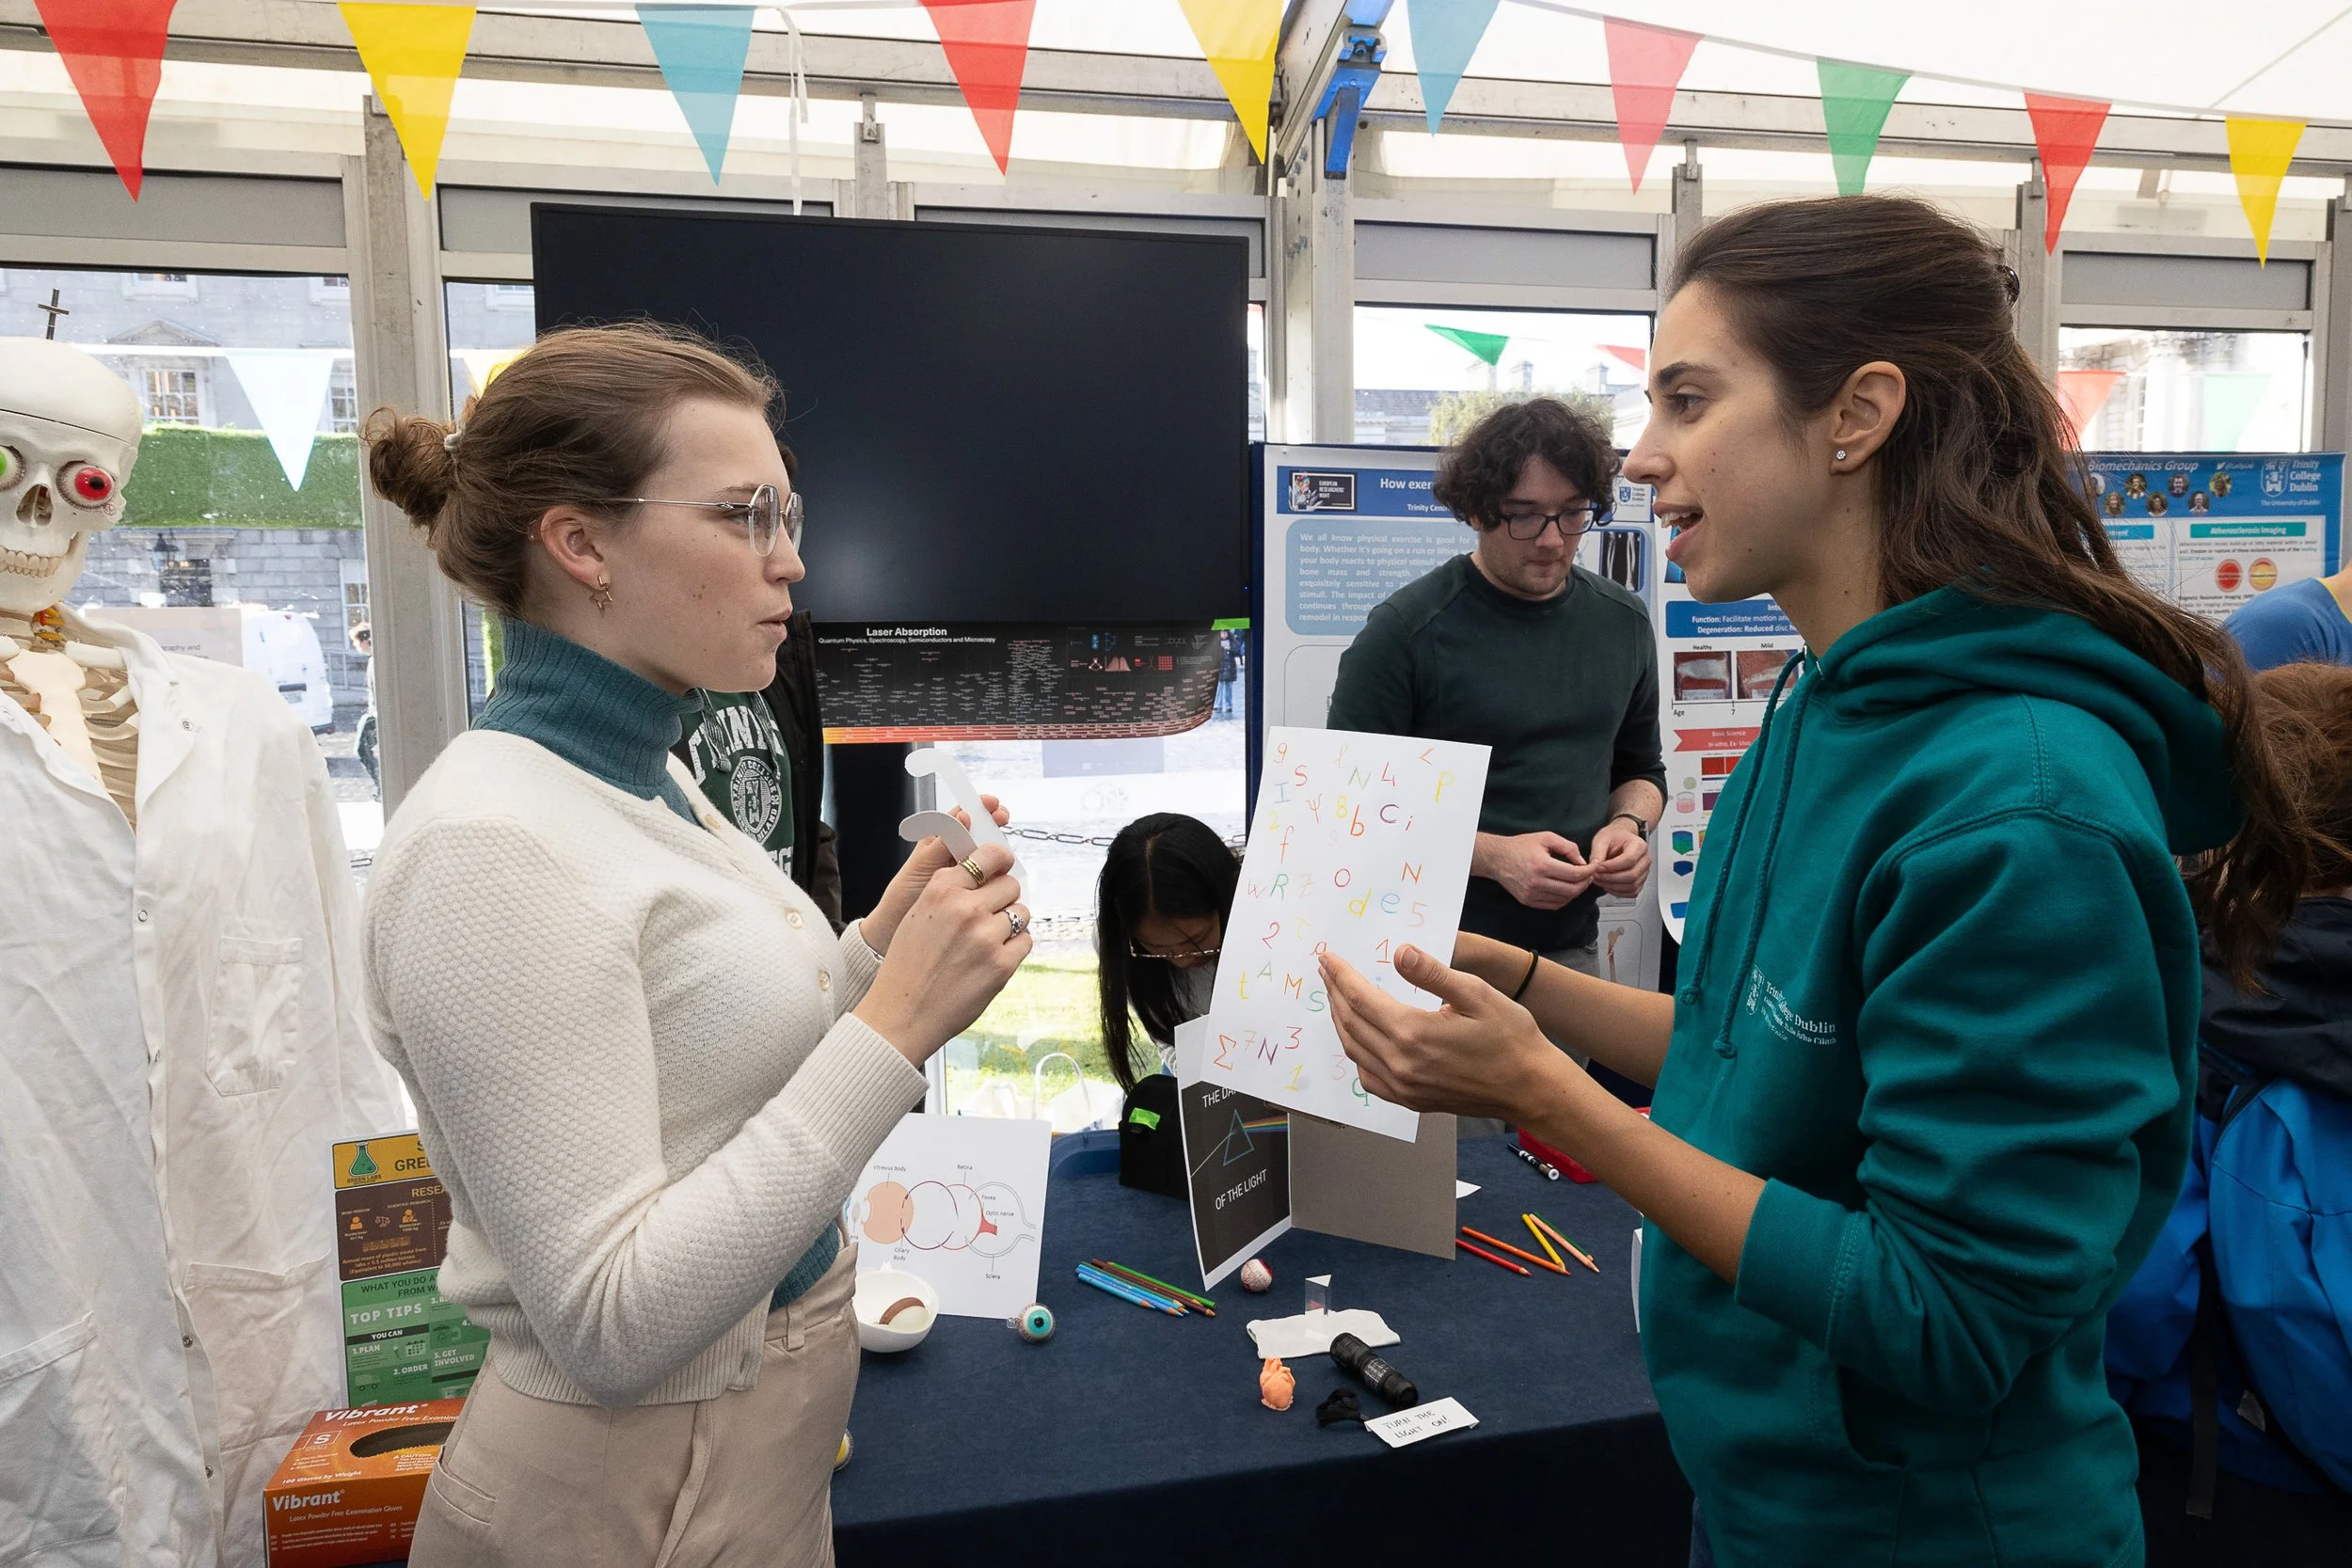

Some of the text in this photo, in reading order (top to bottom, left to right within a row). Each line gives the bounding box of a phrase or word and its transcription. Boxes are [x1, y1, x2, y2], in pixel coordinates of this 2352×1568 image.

[2089, 461, 2198, 472] Biomechanics Group
[2292, 460, 2320, 470] Trinity
[1380, 478, 1433, 489] How exer
[2290, 471, 2321, 482] College
[2290, 482, 2318, 491] Dublin
[1407, 503, 1428, 512] Trinity
[1358, 534, 1387, 543] physical
[1436, 536, 1454, 545] good
[1300, 546, 1321, 554] body.
[1320, 557, 1340, 565] body
[1356, 568, 1370, 577] and
[1348, 592, 1375, 600] impact
[866, 627, 946, 637] Laser Absorption
[1381, 762, 1396, 787] 4
[1336, 796, 1347, 818] 8
[1349, 803, 1364, 836] b
[1279, 825, 1295, 863] f
[1401, 862, 1422, 884] N
[1270, 873, 1289, 902] R
[1347, 887, 1372, 918] d
[1380, 893, 1400, 914] e
[1406, 901, 1428, 928] 5
[1375, 939, 1391, 963] 1
[1256, 960, 1273, 981] A
[1238, 970, 1249, 1000] t
[1283, 973, 1303, 1001] M
[1306, 990, 1325, 1012] S
[1795, 1014, 1836, 1034] Dublin
[1284, 1025, 1303, 1050] 3
[1257, 1037, 1279, 1065] N
[1284, 1063, 1304, 1091] 1
[1202, 1089, 1220, 1108] THE
[1216, 1168, 1267, 1211] OF THE LIGHT
[361, 1282, 389, 1293] WHAT
[391, 1279, 411, 1289] YOU
[398, 1288, 425, 1297] FROM
[350, 1304, 422, 1324] TOP TIPS
[372, 1329, 403, 1340] YOU CAN
[434, 1354, 474, 1367] INVOLVED
[442, 1349, 456, 1357] GET
[402, 1365, 428, 1373] ORDER
[325, 1404, 419, 1422] Vibrant
[368, 1416, 400, 1424] Powder
[1384, 1410, 1436, 1430] TURN THE
[313, 1433, 331, 1445] S
[1394, 1426, 1423, 1438] LIGHT
[273, 1491, 341, 1512] Vibrant
[346, 1508, 382, 1516] Examination
